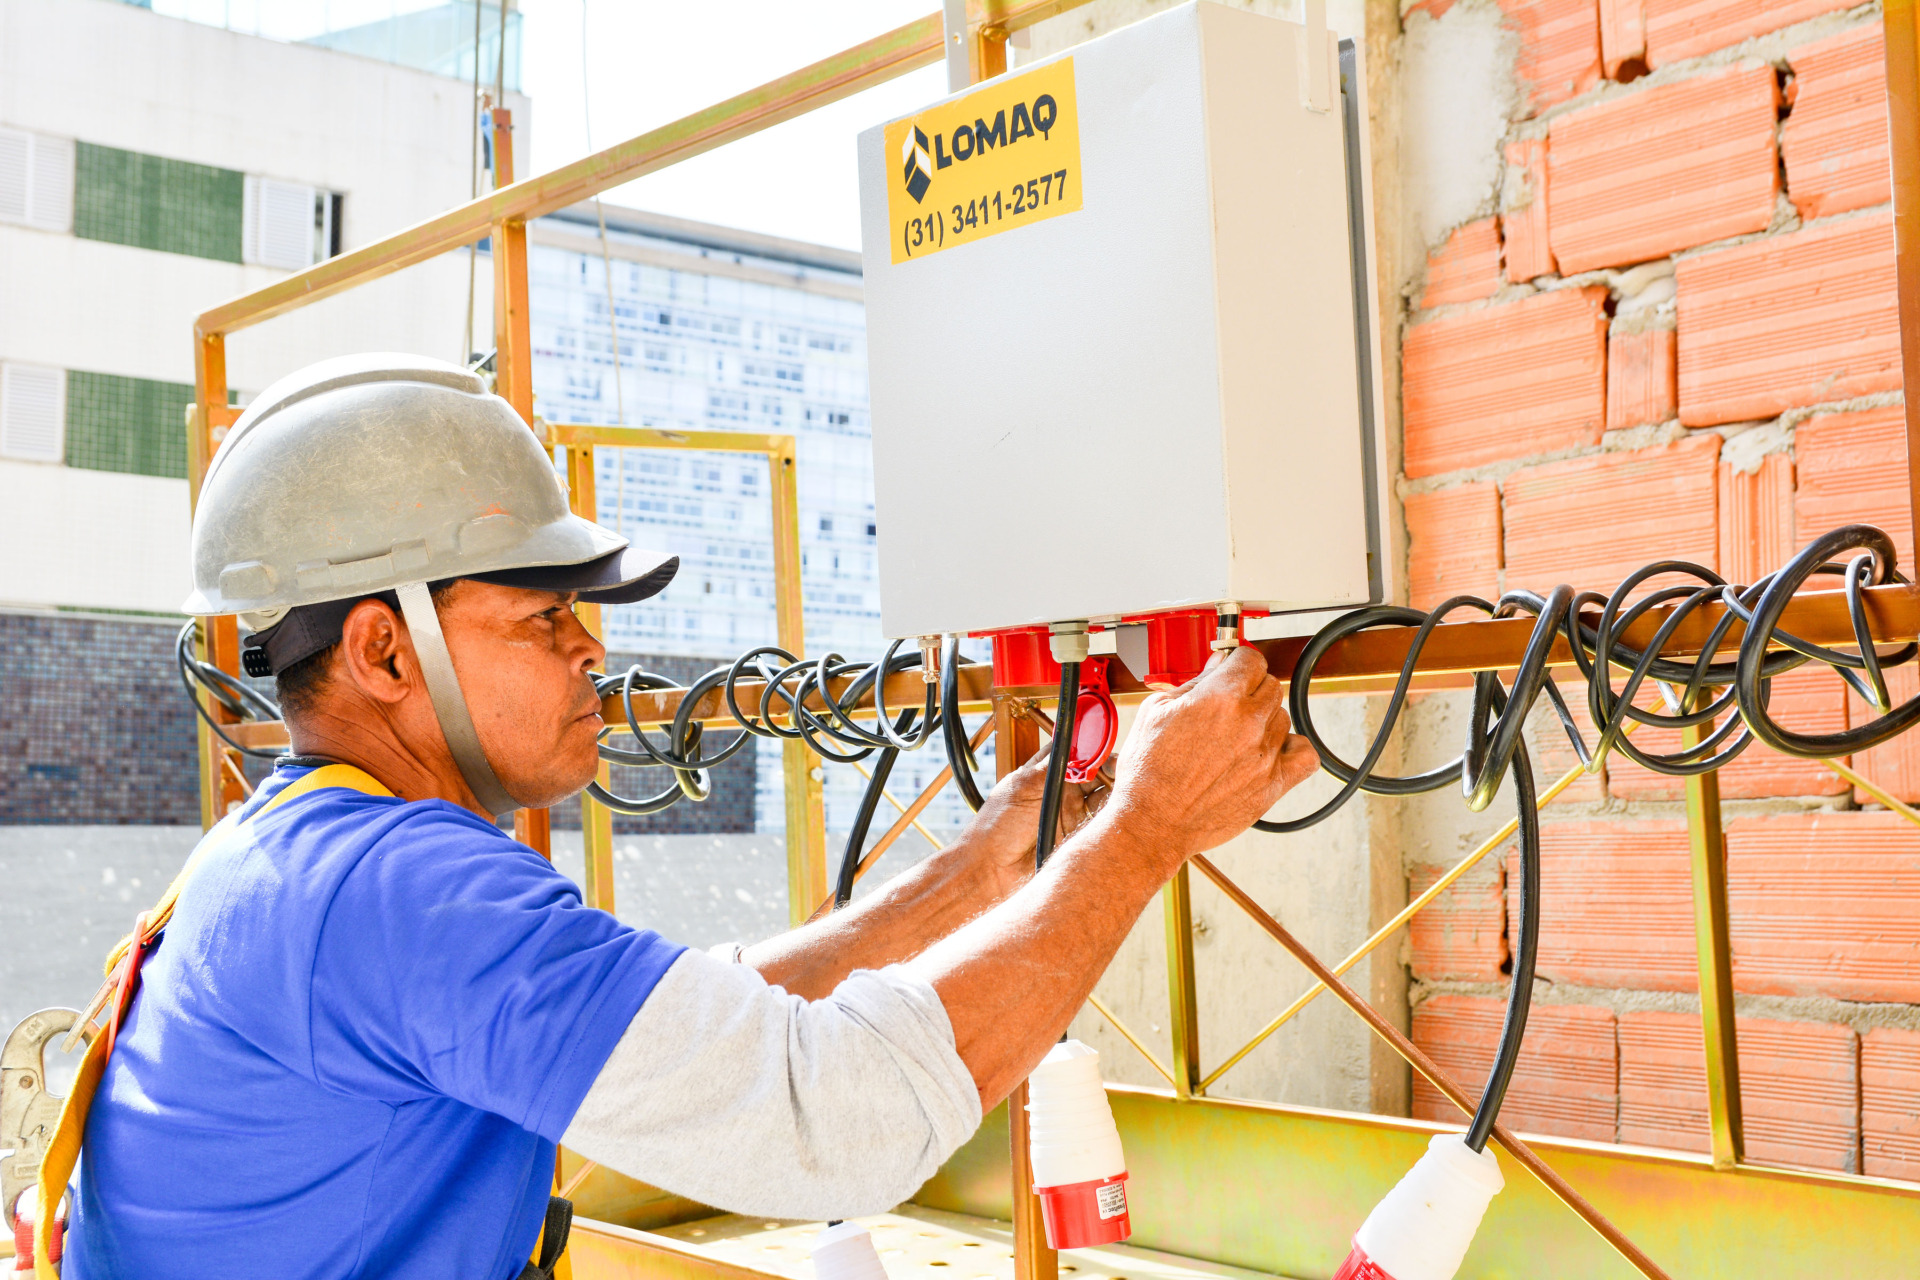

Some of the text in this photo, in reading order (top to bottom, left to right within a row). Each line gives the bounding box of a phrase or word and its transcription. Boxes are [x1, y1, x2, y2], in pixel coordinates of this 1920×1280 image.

[934, 93, 1057, 171] LOMAQ
[904, 168, 1067, 257] (31) 3411-2577
